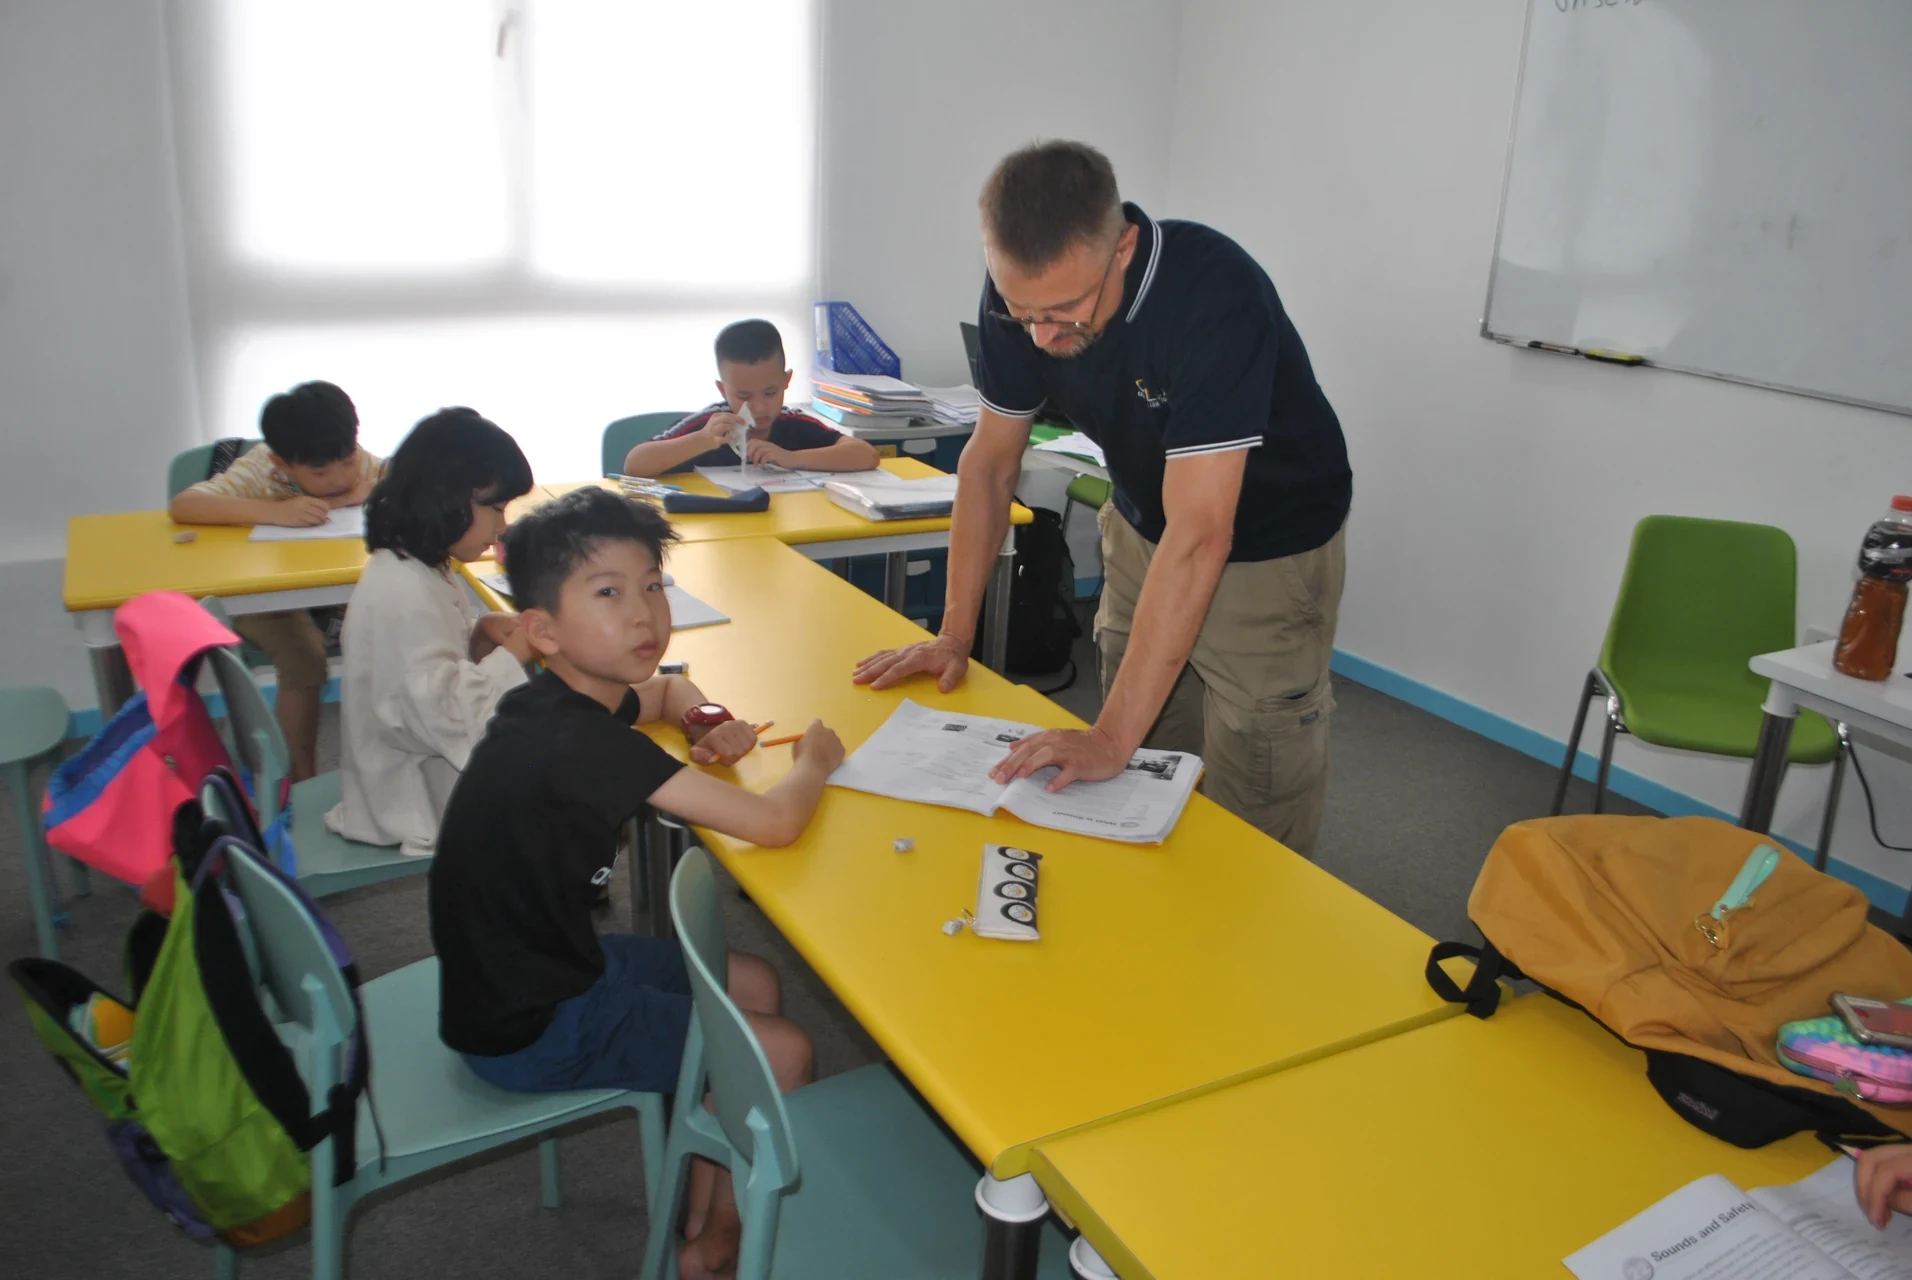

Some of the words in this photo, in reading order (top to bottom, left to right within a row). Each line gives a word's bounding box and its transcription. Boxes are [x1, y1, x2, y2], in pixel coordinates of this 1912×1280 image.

[1651, 1234, 1698, 1262] Sounds
[1698, 1219, 1721, 1239] and
[1718, 1201, 1756, 1223] Safety
